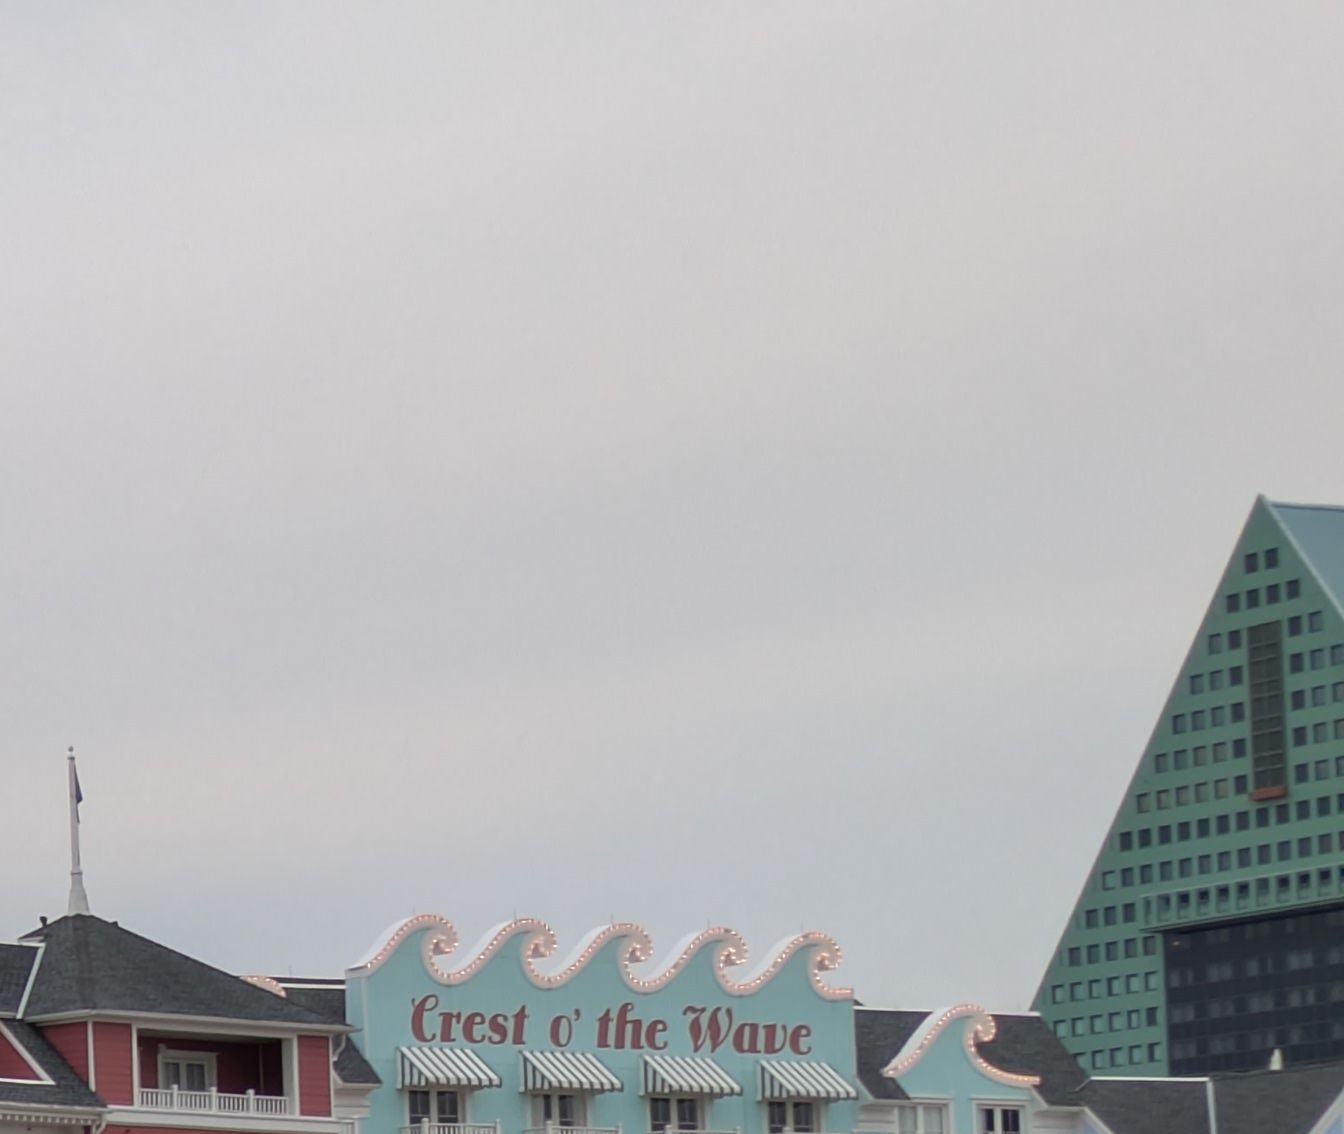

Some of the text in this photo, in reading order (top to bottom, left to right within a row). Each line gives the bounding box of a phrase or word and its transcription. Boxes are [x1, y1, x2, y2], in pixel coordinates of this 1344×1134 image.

[411, 994, 529, 1046] Crest
[597, 1002, 668, 1050] the
[683, 1006, 812, 1055] Wave
